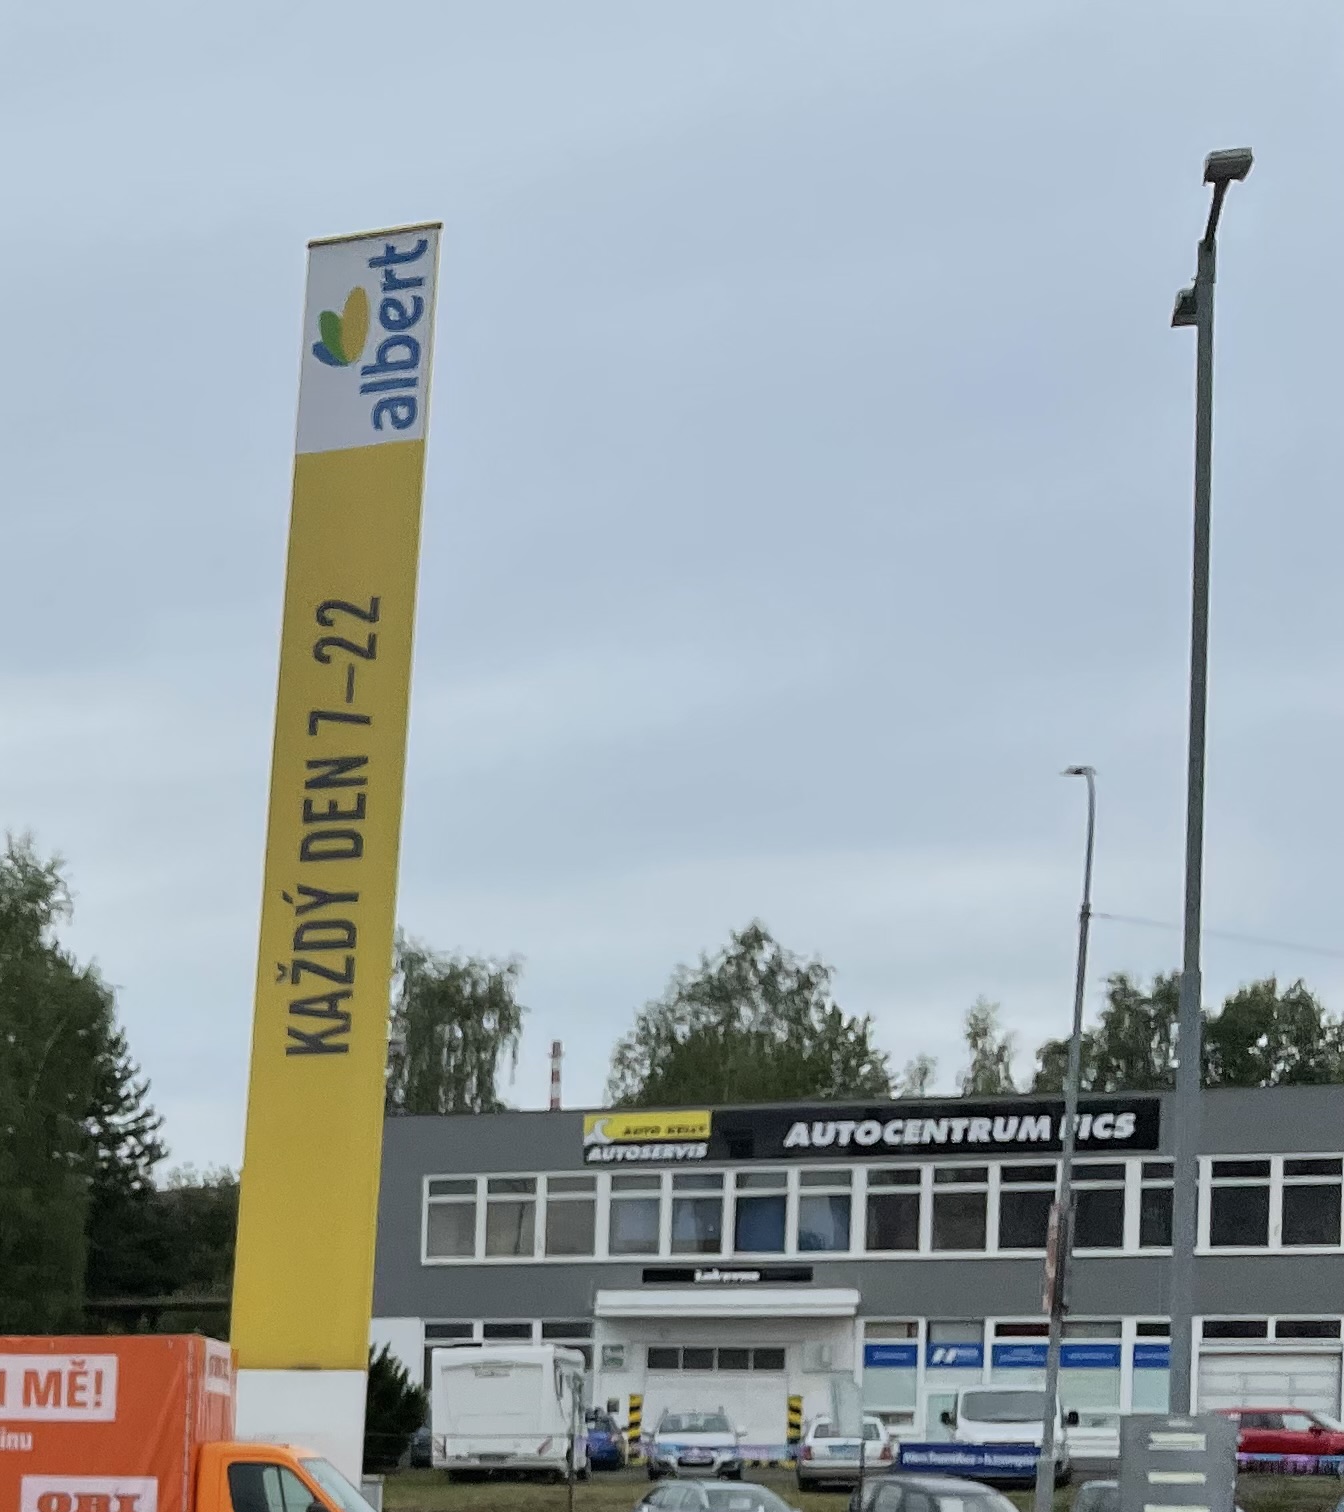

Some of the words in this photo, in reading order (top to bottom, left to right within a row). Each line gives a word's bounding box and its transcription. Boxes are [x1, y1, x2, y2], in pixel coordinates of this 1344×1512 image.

[359, 239, 429, 431] albert
[300, 755, 369, 862] DEN
[275, 883, 359, 1057] KAŽDÝ
[587, 1142, 709, 1162] AUTOSERVIS
[783, 1114, 1051, 1148] AUTOCENTRUM
[22, 1359, 104, 1409] MĚ!
